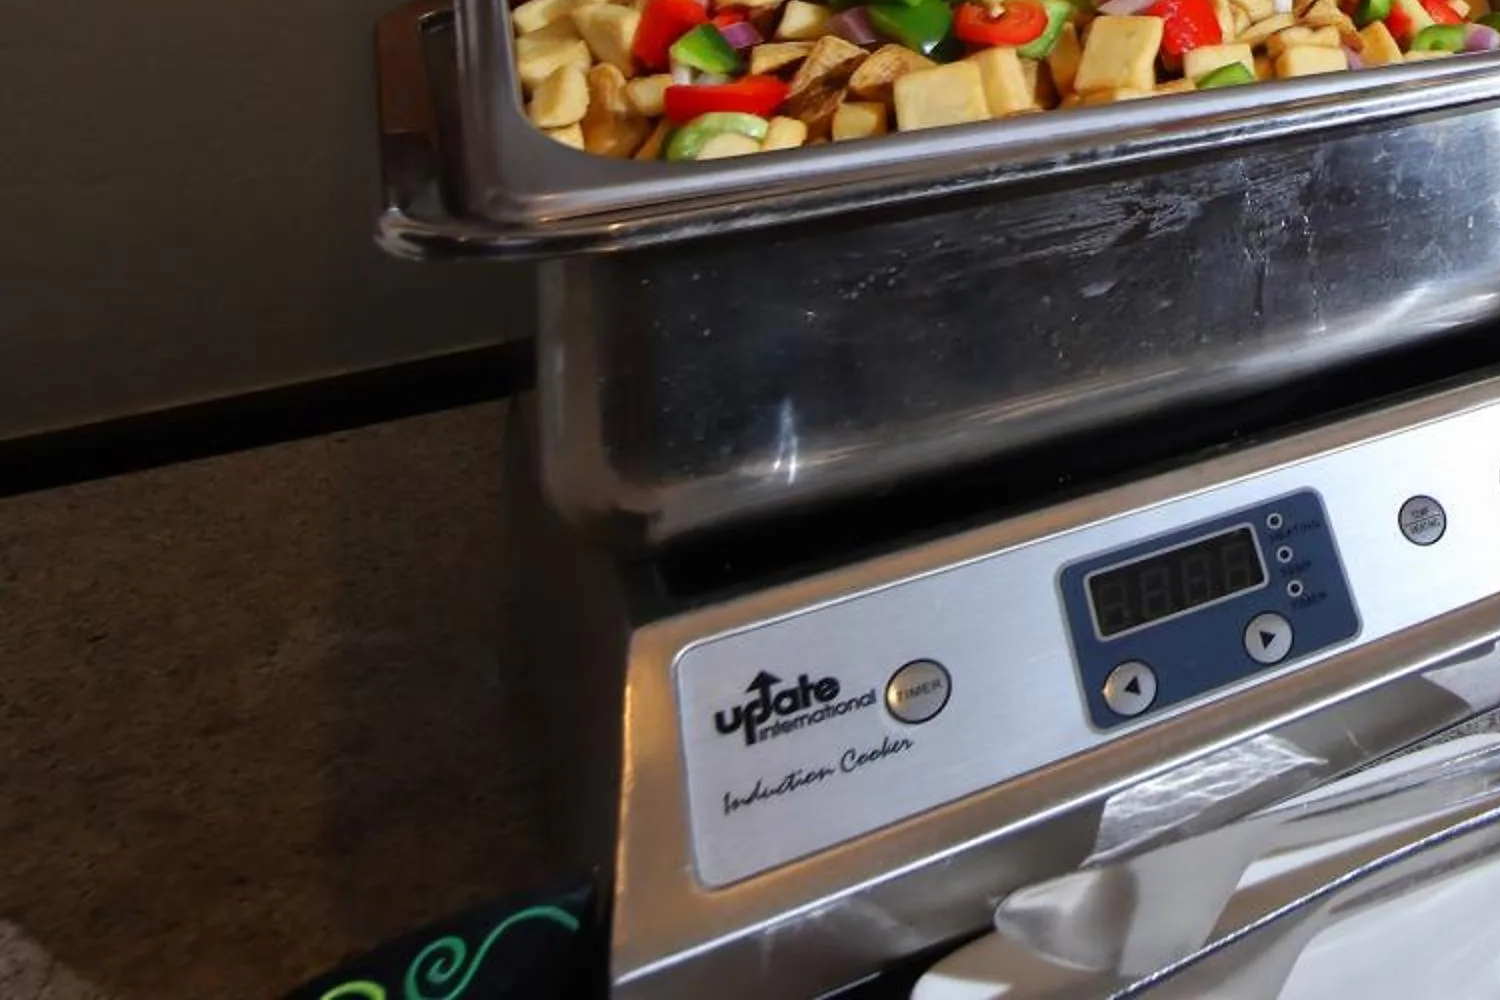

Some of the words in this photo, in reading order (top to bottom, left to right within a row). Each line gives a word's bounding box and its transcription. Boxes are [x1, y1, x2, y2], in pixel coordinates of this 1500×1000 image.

[715, 670, 841, 747] update
[759, 688, 877, 743] international
[896, 678, 943, 704] TIMER
[723, 769, 835, 815] Induction
[840, 736, 914, 773] Cooker
